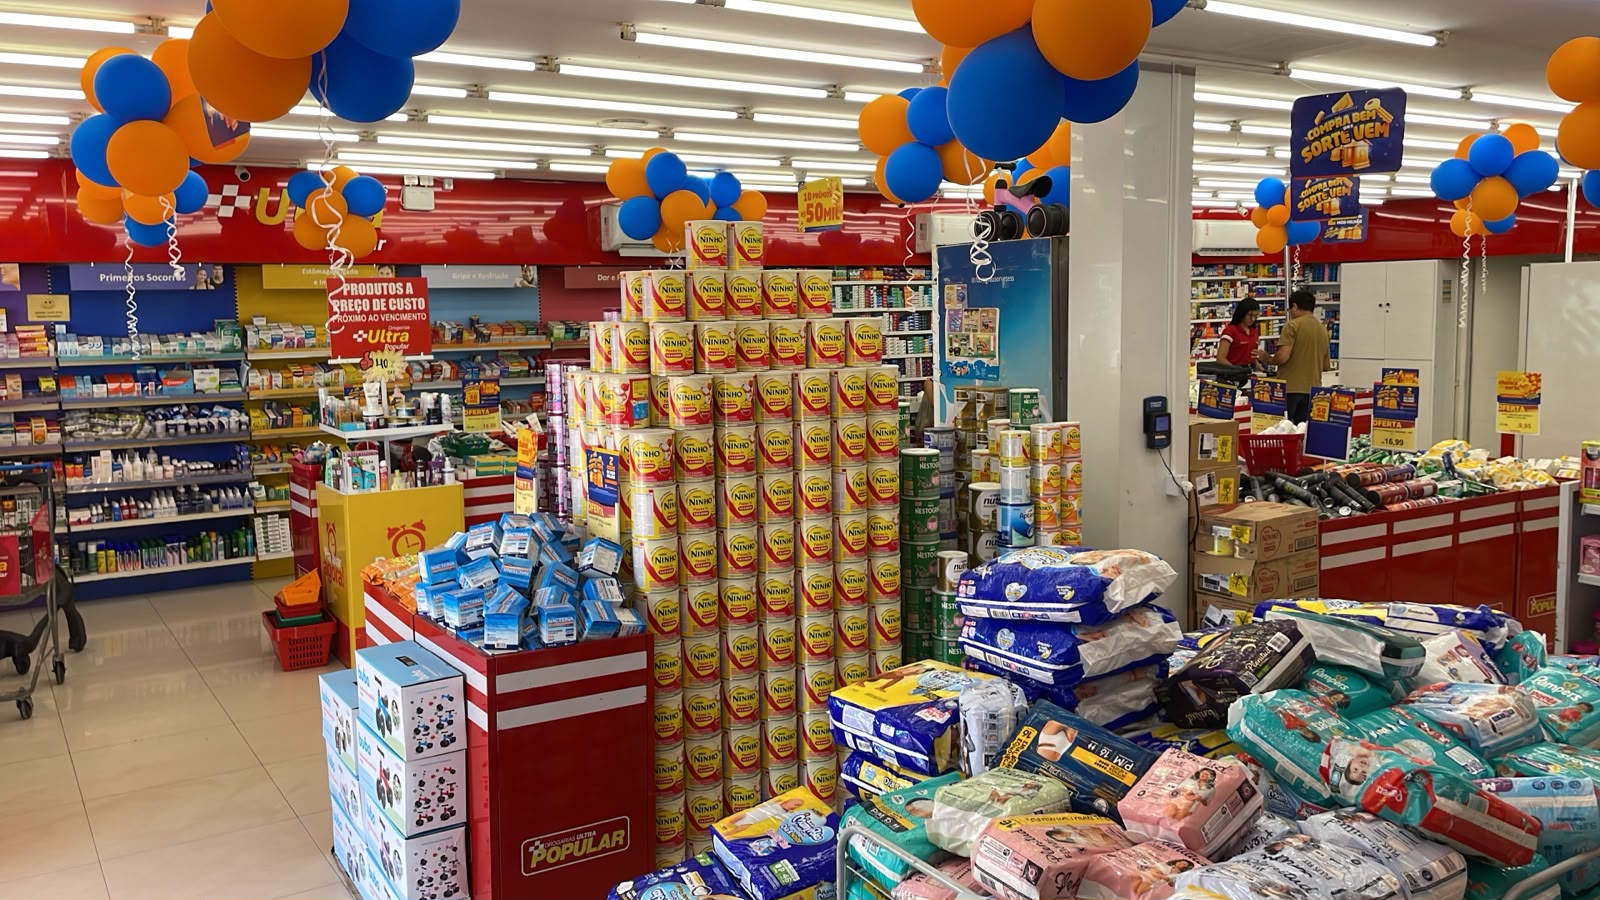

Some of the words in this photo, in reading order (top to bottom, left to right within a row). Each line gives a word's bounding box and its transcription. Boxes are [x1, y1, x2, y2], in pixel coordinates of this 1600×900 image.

[1306, 114, 1351, 140] COMPRA
[1351, 109, 1377, 123] BEM
[1300, 129, 1351, 164] SORTE
[1353, 121, 1390, 141] VEM
[1300, 182, 1328, 199] COMPRA
[1328, 178, 1343, 188] BEM
[803, 192, 812, 202] 10
[1297, 192, 1328, 213] SORTE
[1329, 186, 1351, 198] VEM
[806, 202, 824, 223] 50
[823, 206, 840, 222] MIL
[700, 236, 723, 244] NINHO
[452, 272, 474, 281] Gripe
[479, 272, 509, 280] Resfriado
[342, 282, 404, 296] PRODUTOS
[405, 282, 414, 294] A
[662, 285, 684, 294] NINHO
[733, 285, 757, 293] NINHO
[771, 285, 794, 293] NINHO
[807, 284, 830, 292] NINHO
[332, 299, 370, 314] PREÇO
[372, 298, 387, 311] DE
[389, 297, 425, 311] CUSTO
[368, 313, 379, 322] AO
[379, 312, 427, 322] VENCIMENTO
[367, 329, 410, 344] Ultra
[742, 336, 766, 344] NINHO
[775, 335, 800, 343] NINHO
[819, 334, 842, 342] NINHO
[857, 332, 880, 341] NINHO
[661, 339, 687, 348] NINHO
[704, 337, 729, 346] NINHO
[873, 382, 896, 390] NINHO
[766, 388, 789, 396] NINHO
[676, 393, 702, 401] NINHO
[1373, 419, 1402, 428] OFERTA
[875, 429, 897, 437] NINHO
[724, 442, 750, 450] NINHO
[1384, 437, 1404, 446] 16,99
[634, 450, 661, 458] NINHO
[682, 446, 709, 454] NINHO
[875, 476, 897, 484] NINHO
[807, 484, 830, 492] NINHO
[688, 497, 713, 506] NINHO
[983, 497, 1000, 506] nut
[809, 533, 831, 542] NINHO
[732, 543, 756, 552] NINHO
[690, 548, 714, 559] NINHO
[844, 576, 866, 585] NINHO
[811, 582, 832, 591] NINHO
[766, 588, 790, 596] NINHO
[727, 593, 752, 602] NINHO
[1530, 596, 1555, 614] POPUL
[847, 623, 868, 633] NINHO
[808, 630, 832, 639] NINHO
[772, 635, 794, 645] NINHO
[736, 641, 758, 653] NINHO
[693, 650, 717, 661] NINHO
[654, 659, 679, 670] NINHO
[847, 670, 868, 679] NINHO
[1311, 667, 1350, 691] Pampers
[773, 684, 795, 694] NINHO
[1531, 675, 1583, 702] Pampers
[732, 692, 756, 703] NINHO
[691, 702, 716, 713] NINHO
[654, 711, 679, 722] NINHO
[773, 732, 796, 743] NINHO
[737, 741, 760, 752] NINHO
[693, 753, 718, 763] NINHO
[1100, 748, 1111, 759] 16
[1112, 755, 1135, 772] P/M
[730, 792, 755, 803] NINHO
[694, 802, 719, 814] NINHO
[576, 830, 597, 840] ULTRA
[530, 829, 625, 868] POPULAR
